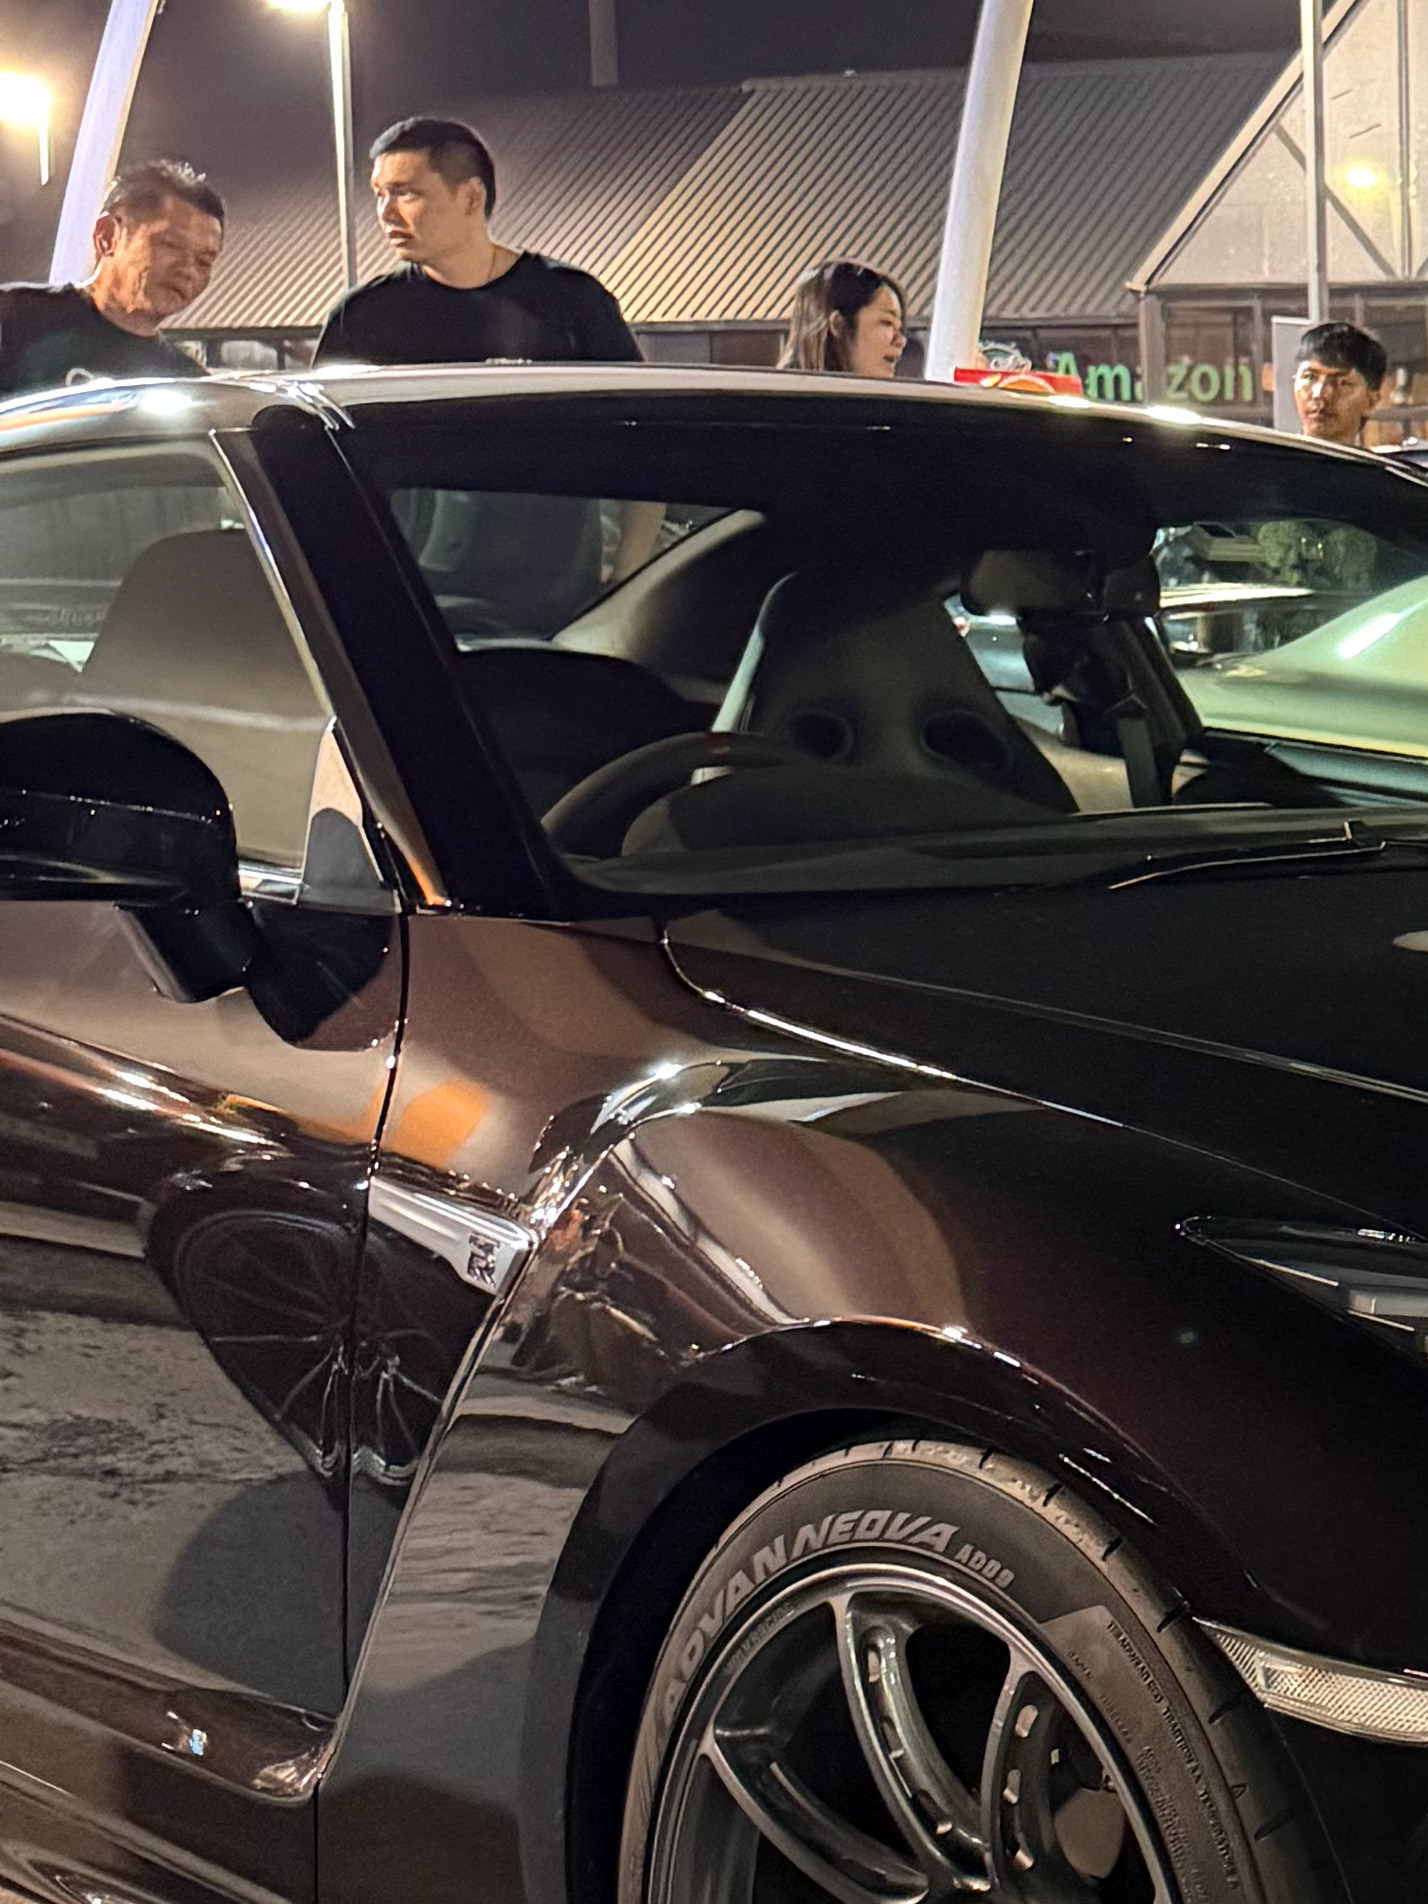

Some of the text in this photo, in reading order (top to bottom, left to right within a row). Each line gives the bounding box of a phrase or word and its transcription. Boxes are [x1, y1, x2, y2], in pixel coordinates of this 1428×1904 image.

[663, 1509, 1016, 1717] ADVAN NEOVA AD09
